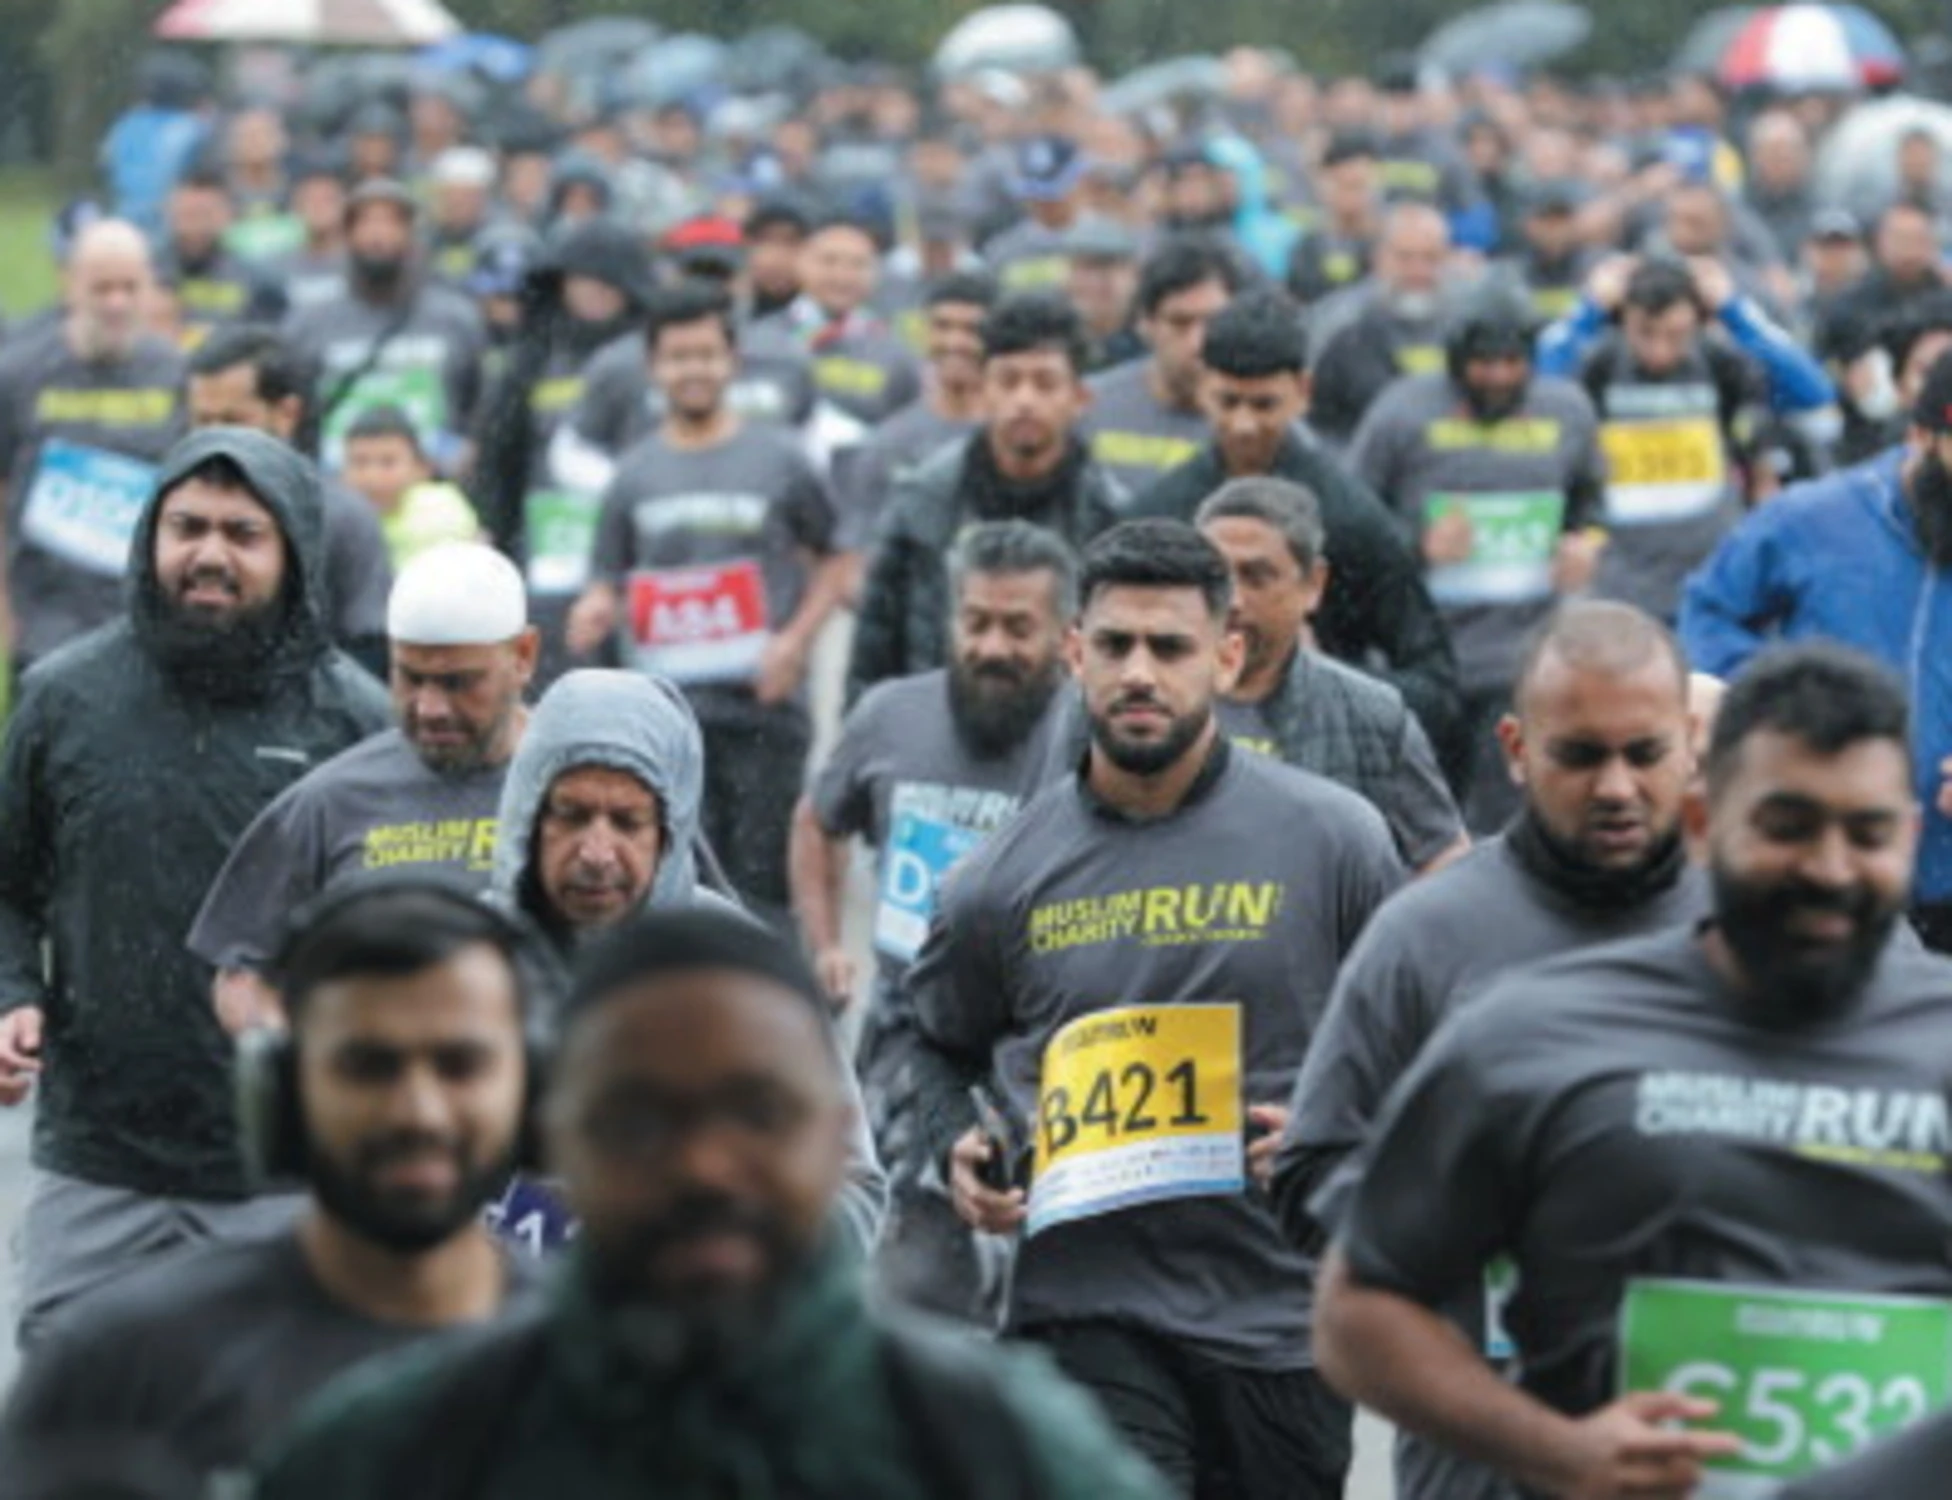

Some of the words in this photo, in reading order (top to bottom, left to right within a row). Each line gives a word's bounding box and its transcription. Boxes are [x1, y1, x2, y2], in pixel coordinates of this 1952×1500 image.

[1032, 888, 1143, 926] MUSLIM
[1145, 882, 1275, 931] RUN
[1032, 916, 1139, 955] CHARITY
[1042, 1057, 1210, 1158] B421
